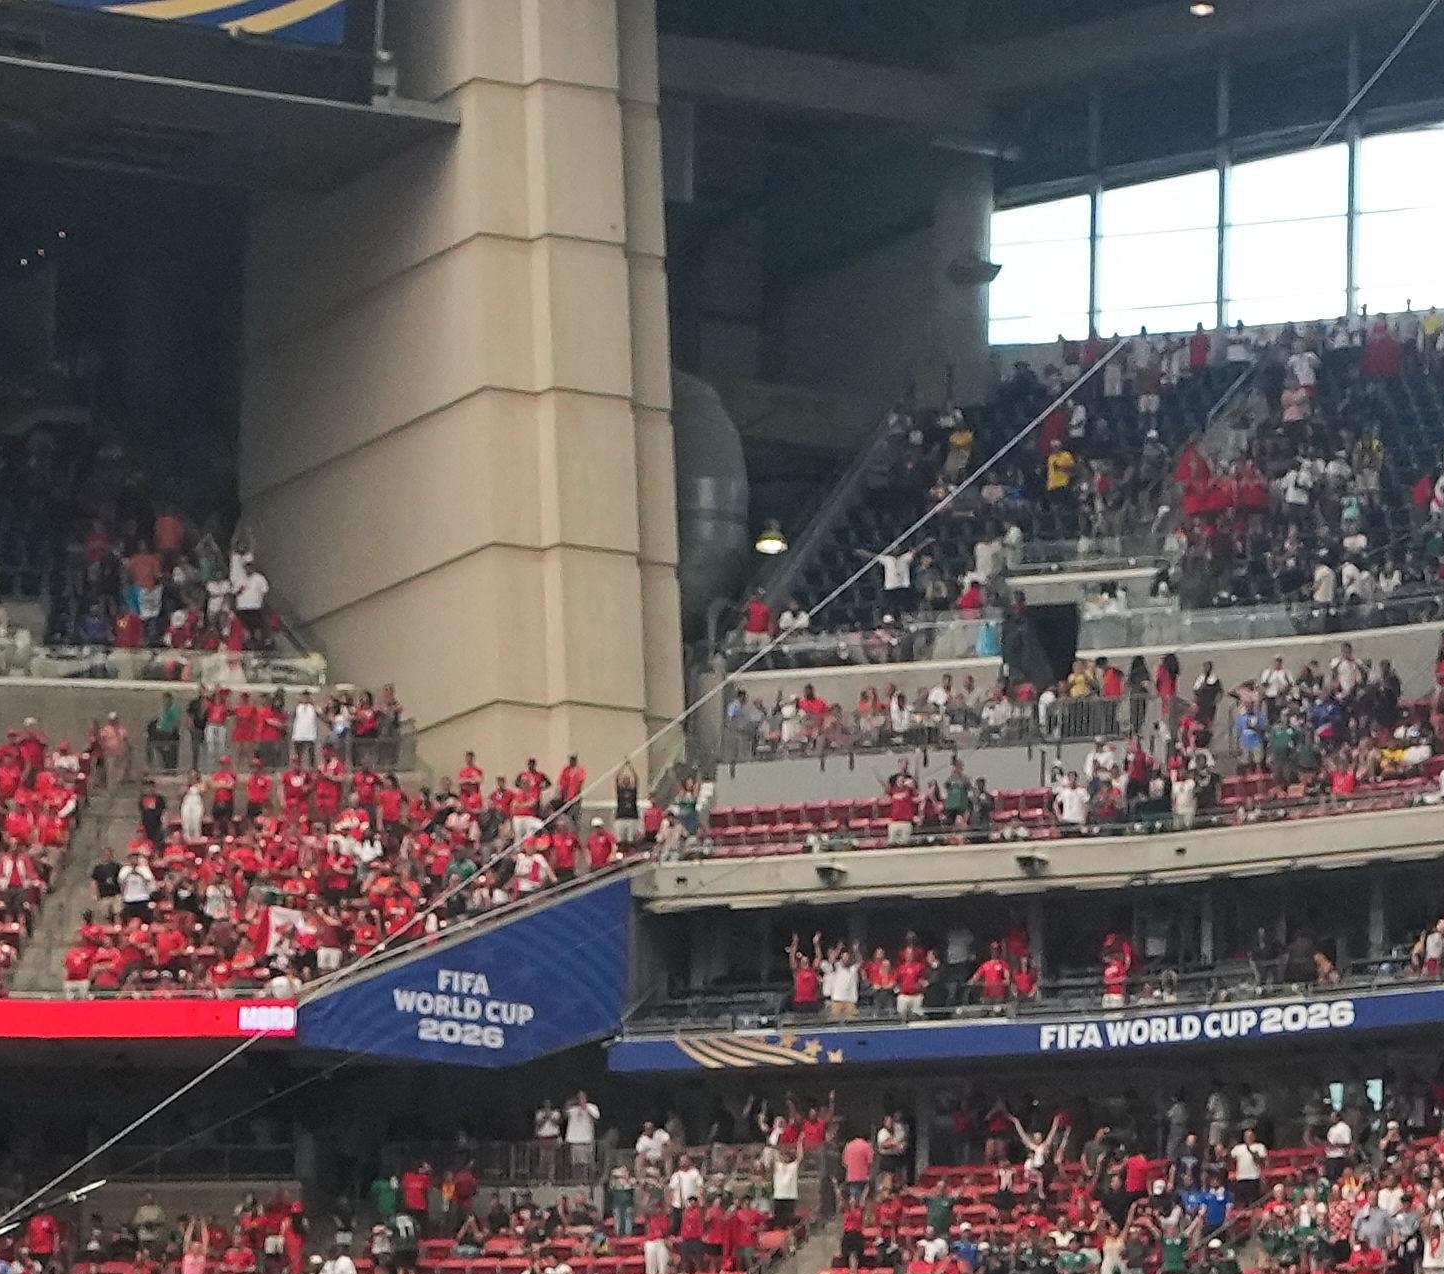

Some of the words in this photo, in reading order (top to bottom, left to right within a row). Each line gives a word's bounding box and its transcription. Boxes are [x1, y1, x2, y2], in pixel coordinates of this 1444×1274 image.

[437, 969, 490, 997] FIFA
[393, 987, 481, 1021] WORLD
[485, 1000, 535, 1026] CUP
[417, 1018, 505, 1049] 2026
[1039, 1022, 1103, 1050] FIFA
[1105, 1014, 1201, 1047] WORLD
[1204, 1009, 1257, 1039] CUP
[1259, 1000, 1355, 1034] 2026
